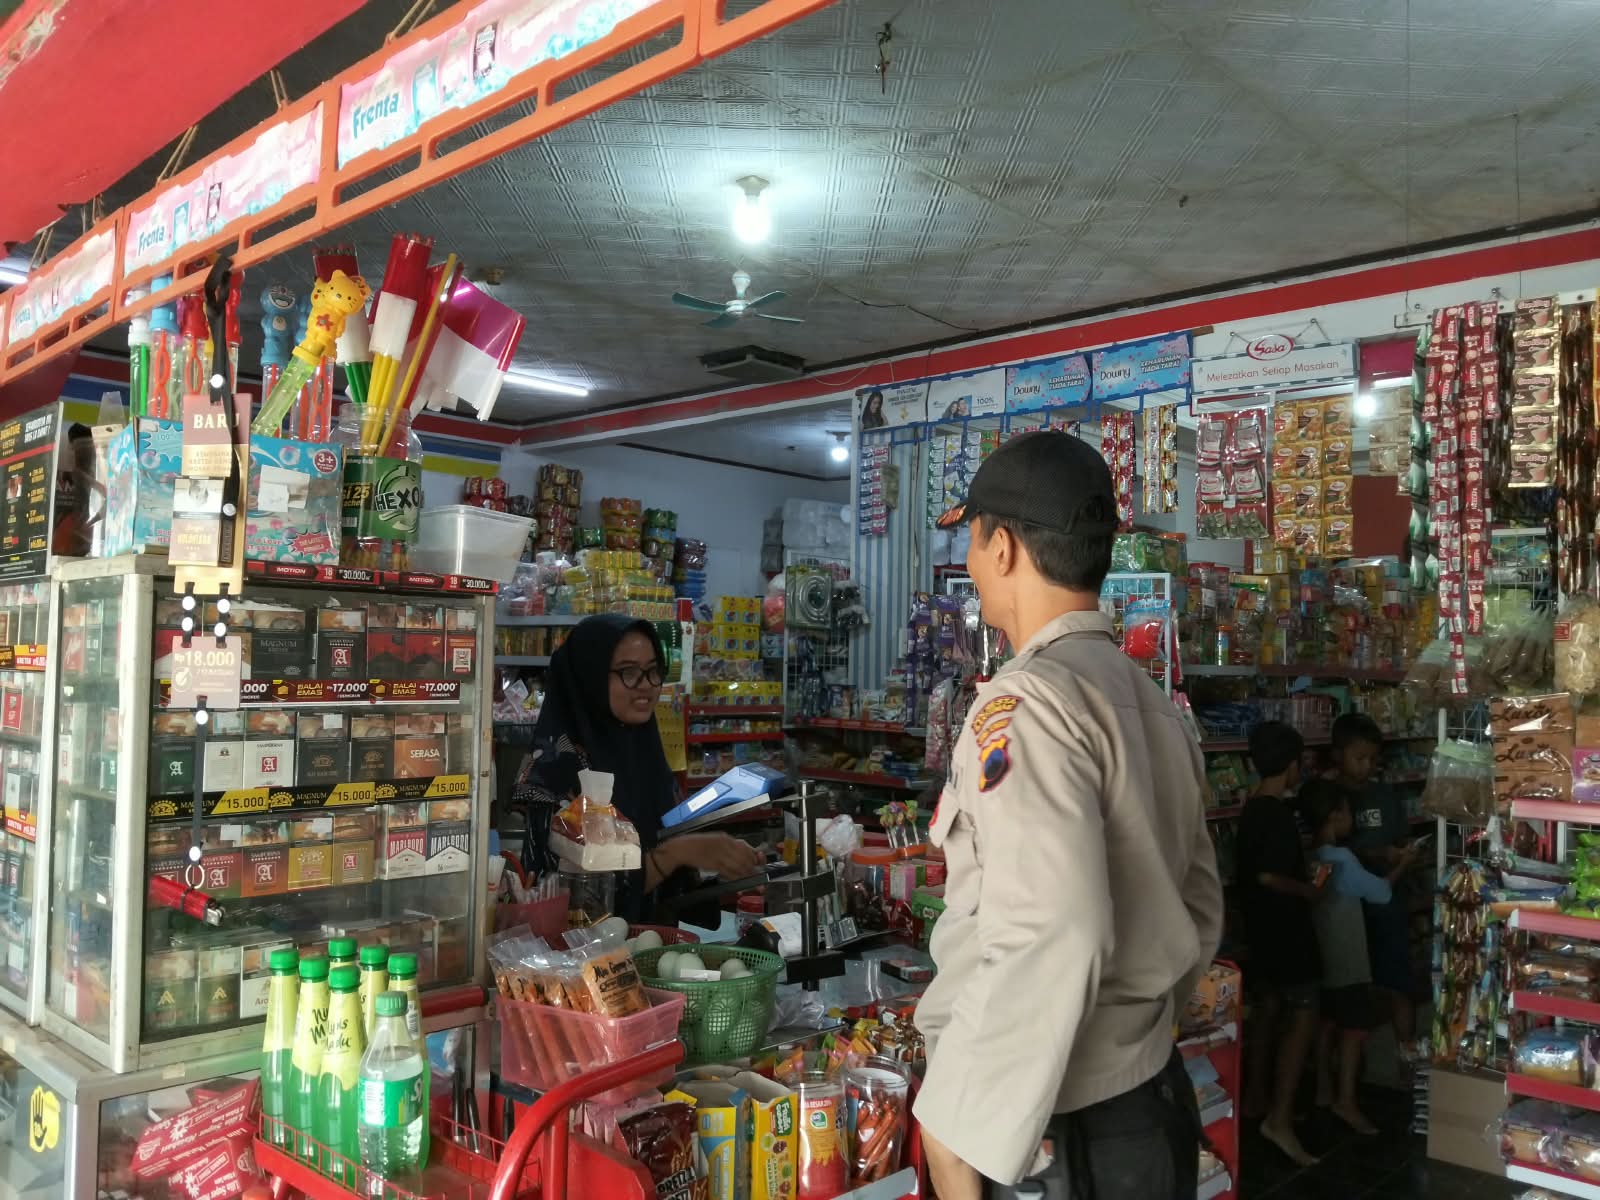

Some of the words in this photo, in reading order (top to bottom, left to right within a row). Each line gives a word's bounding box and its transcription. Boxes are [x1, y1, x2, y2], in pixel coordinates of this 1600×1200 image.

[353, 93, 399, 139] Frenta
[138, 227, 165, 256] Frenta
[1254, 338, 1285, 356] Sasa
[1100, 367, 1131, 381] Downy
[1207, 367, 1258, 382] Melezatkan
[1262, 366, 1291, 376] Setiap
[1295, 361, 1339, 373] Masakan
[1014, 385, 1041, 395] Downy
[977, 396, 994, 405] 100%
[193, 413, 240, 429] BARU
[318, 453, 334, 463] 3+
[353, 486, 370, 499] 25
[410, 749, 440, 759] SERASA
[296, 792, 327, 801] MAGNUM
[390, 838, 424, 856] MARLBORO
[430, 834, 469, 857] MARLBORO
